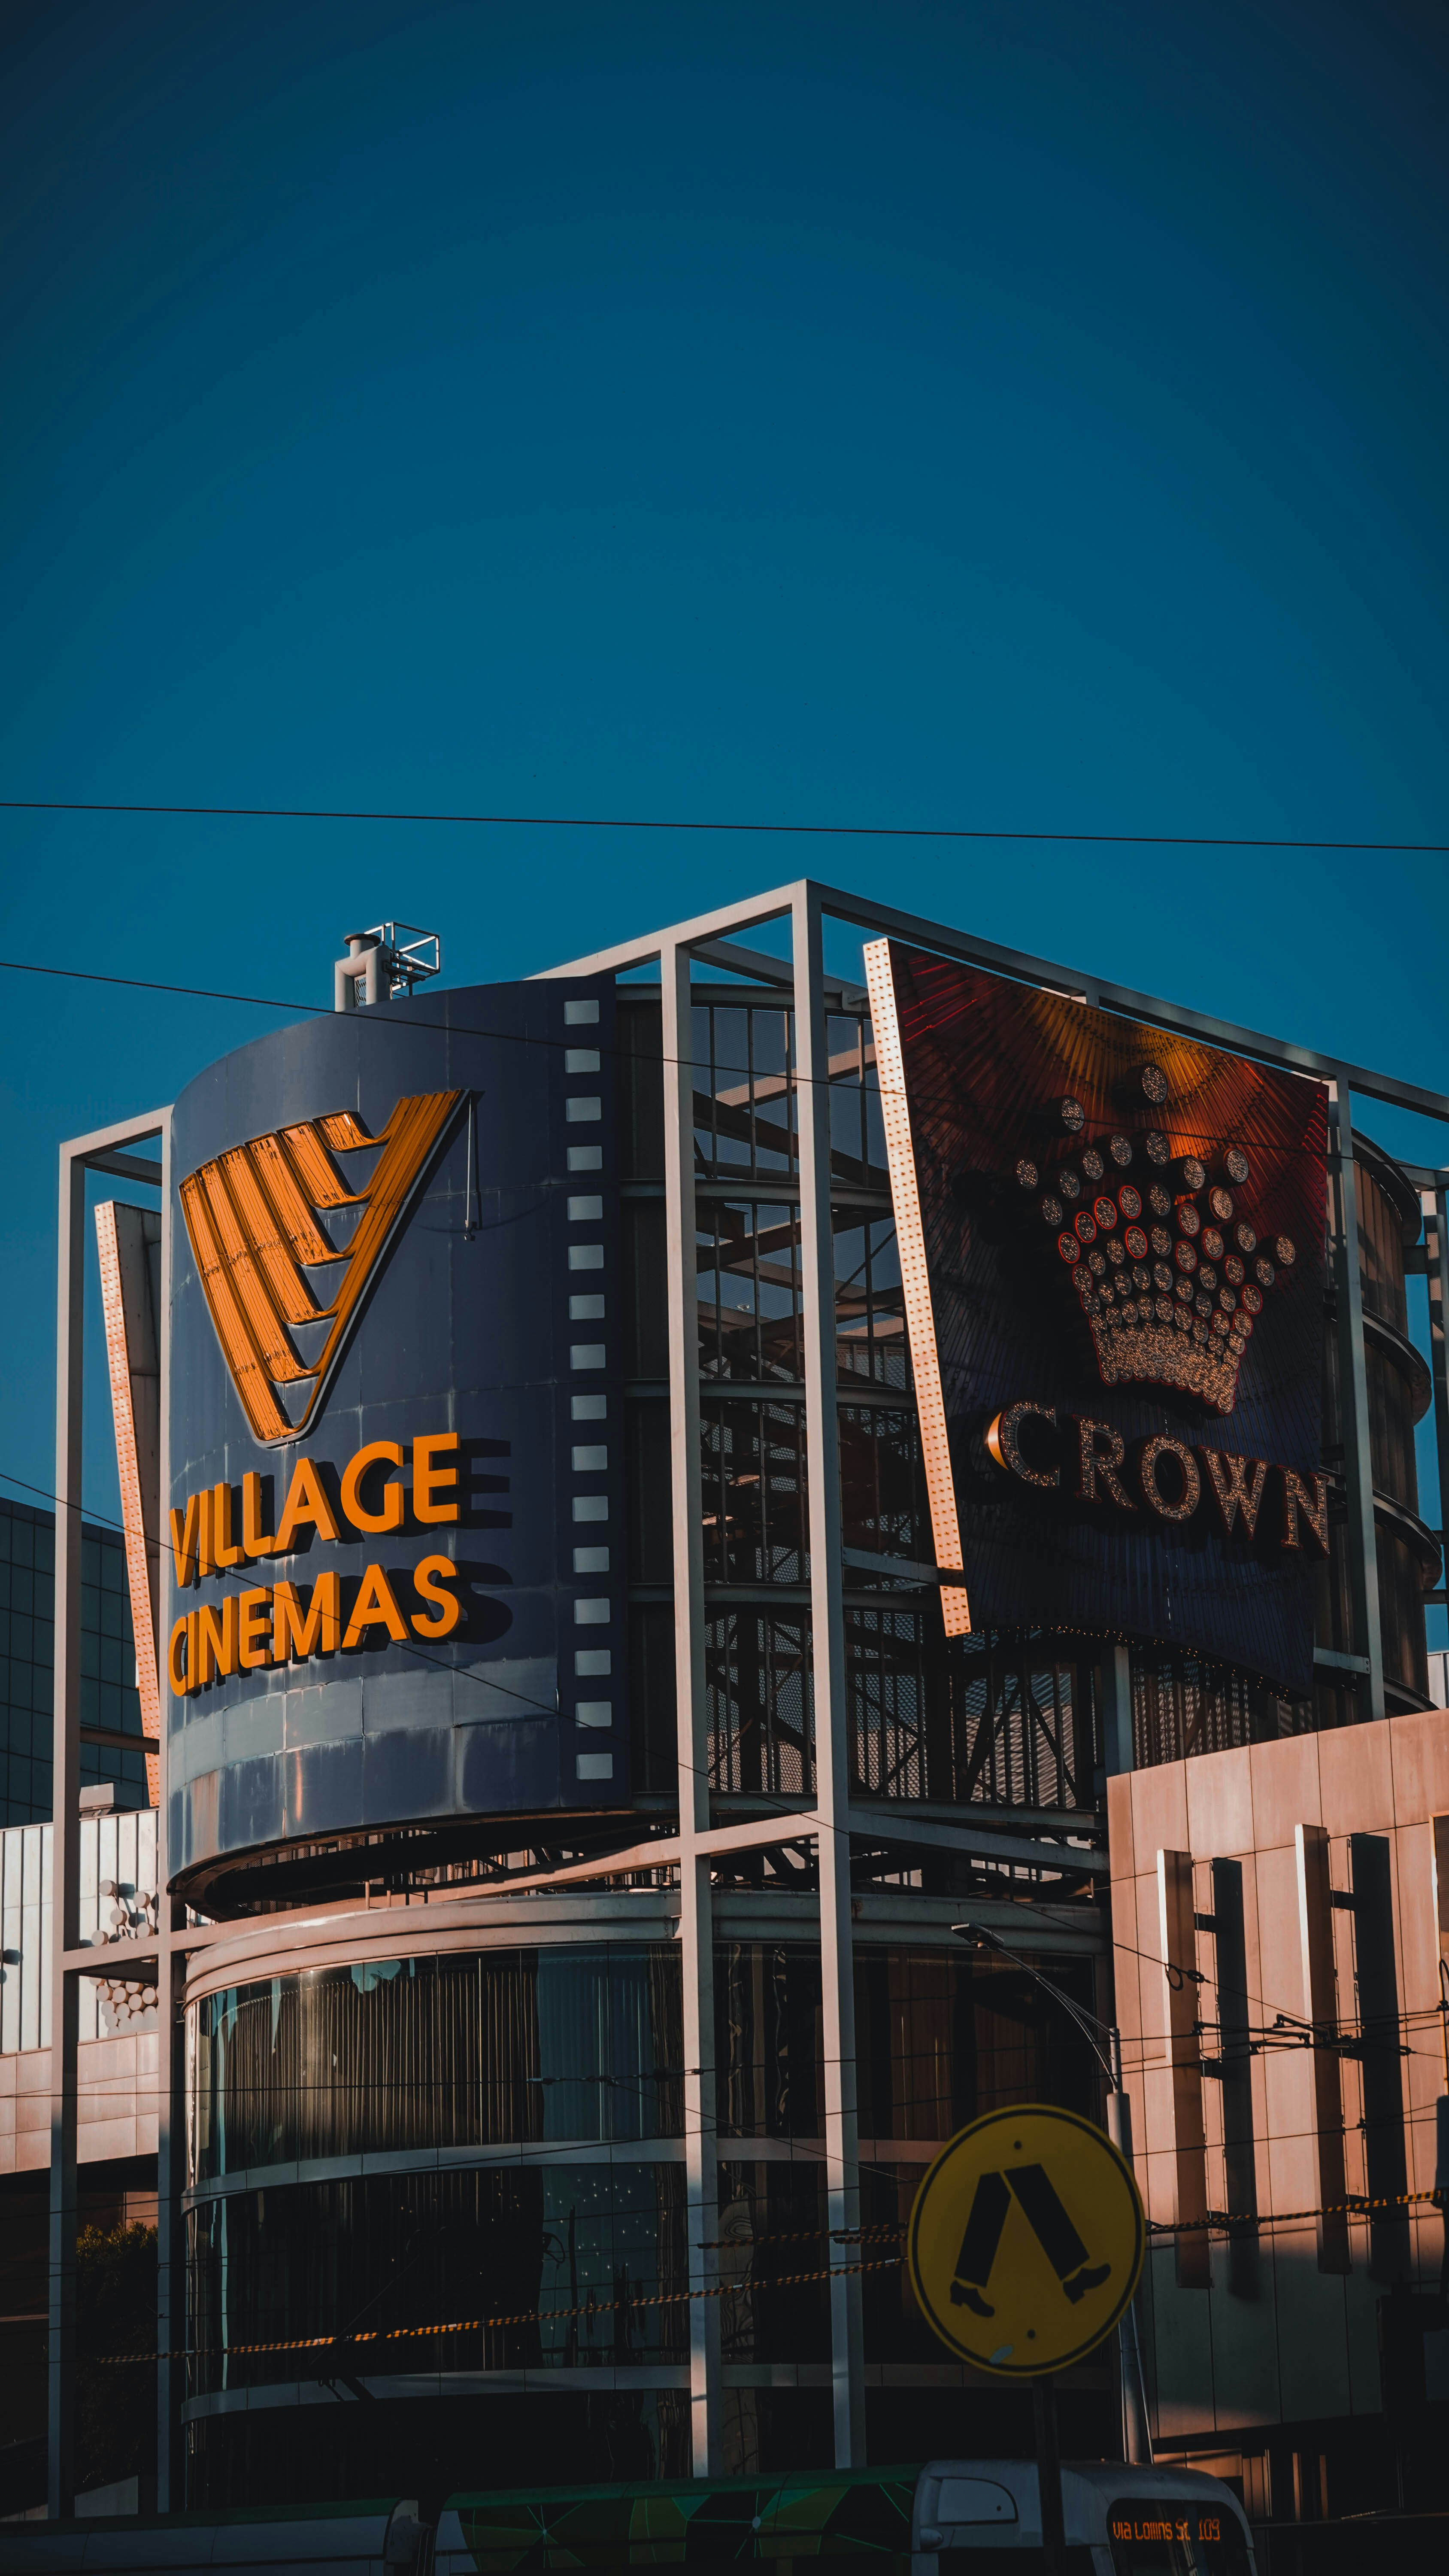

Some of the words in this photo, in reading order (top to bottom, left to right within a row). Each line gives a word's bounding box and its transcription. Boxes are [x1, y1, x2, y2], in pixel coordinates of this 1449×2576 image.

[169, 1432, 461, 1588] VILLAGE
[998, 1400, 1331, 1559] CROWN
[169, 1555, 462, 1697] CINEMAS
[1198, 2517, 1221, 2541] 109
